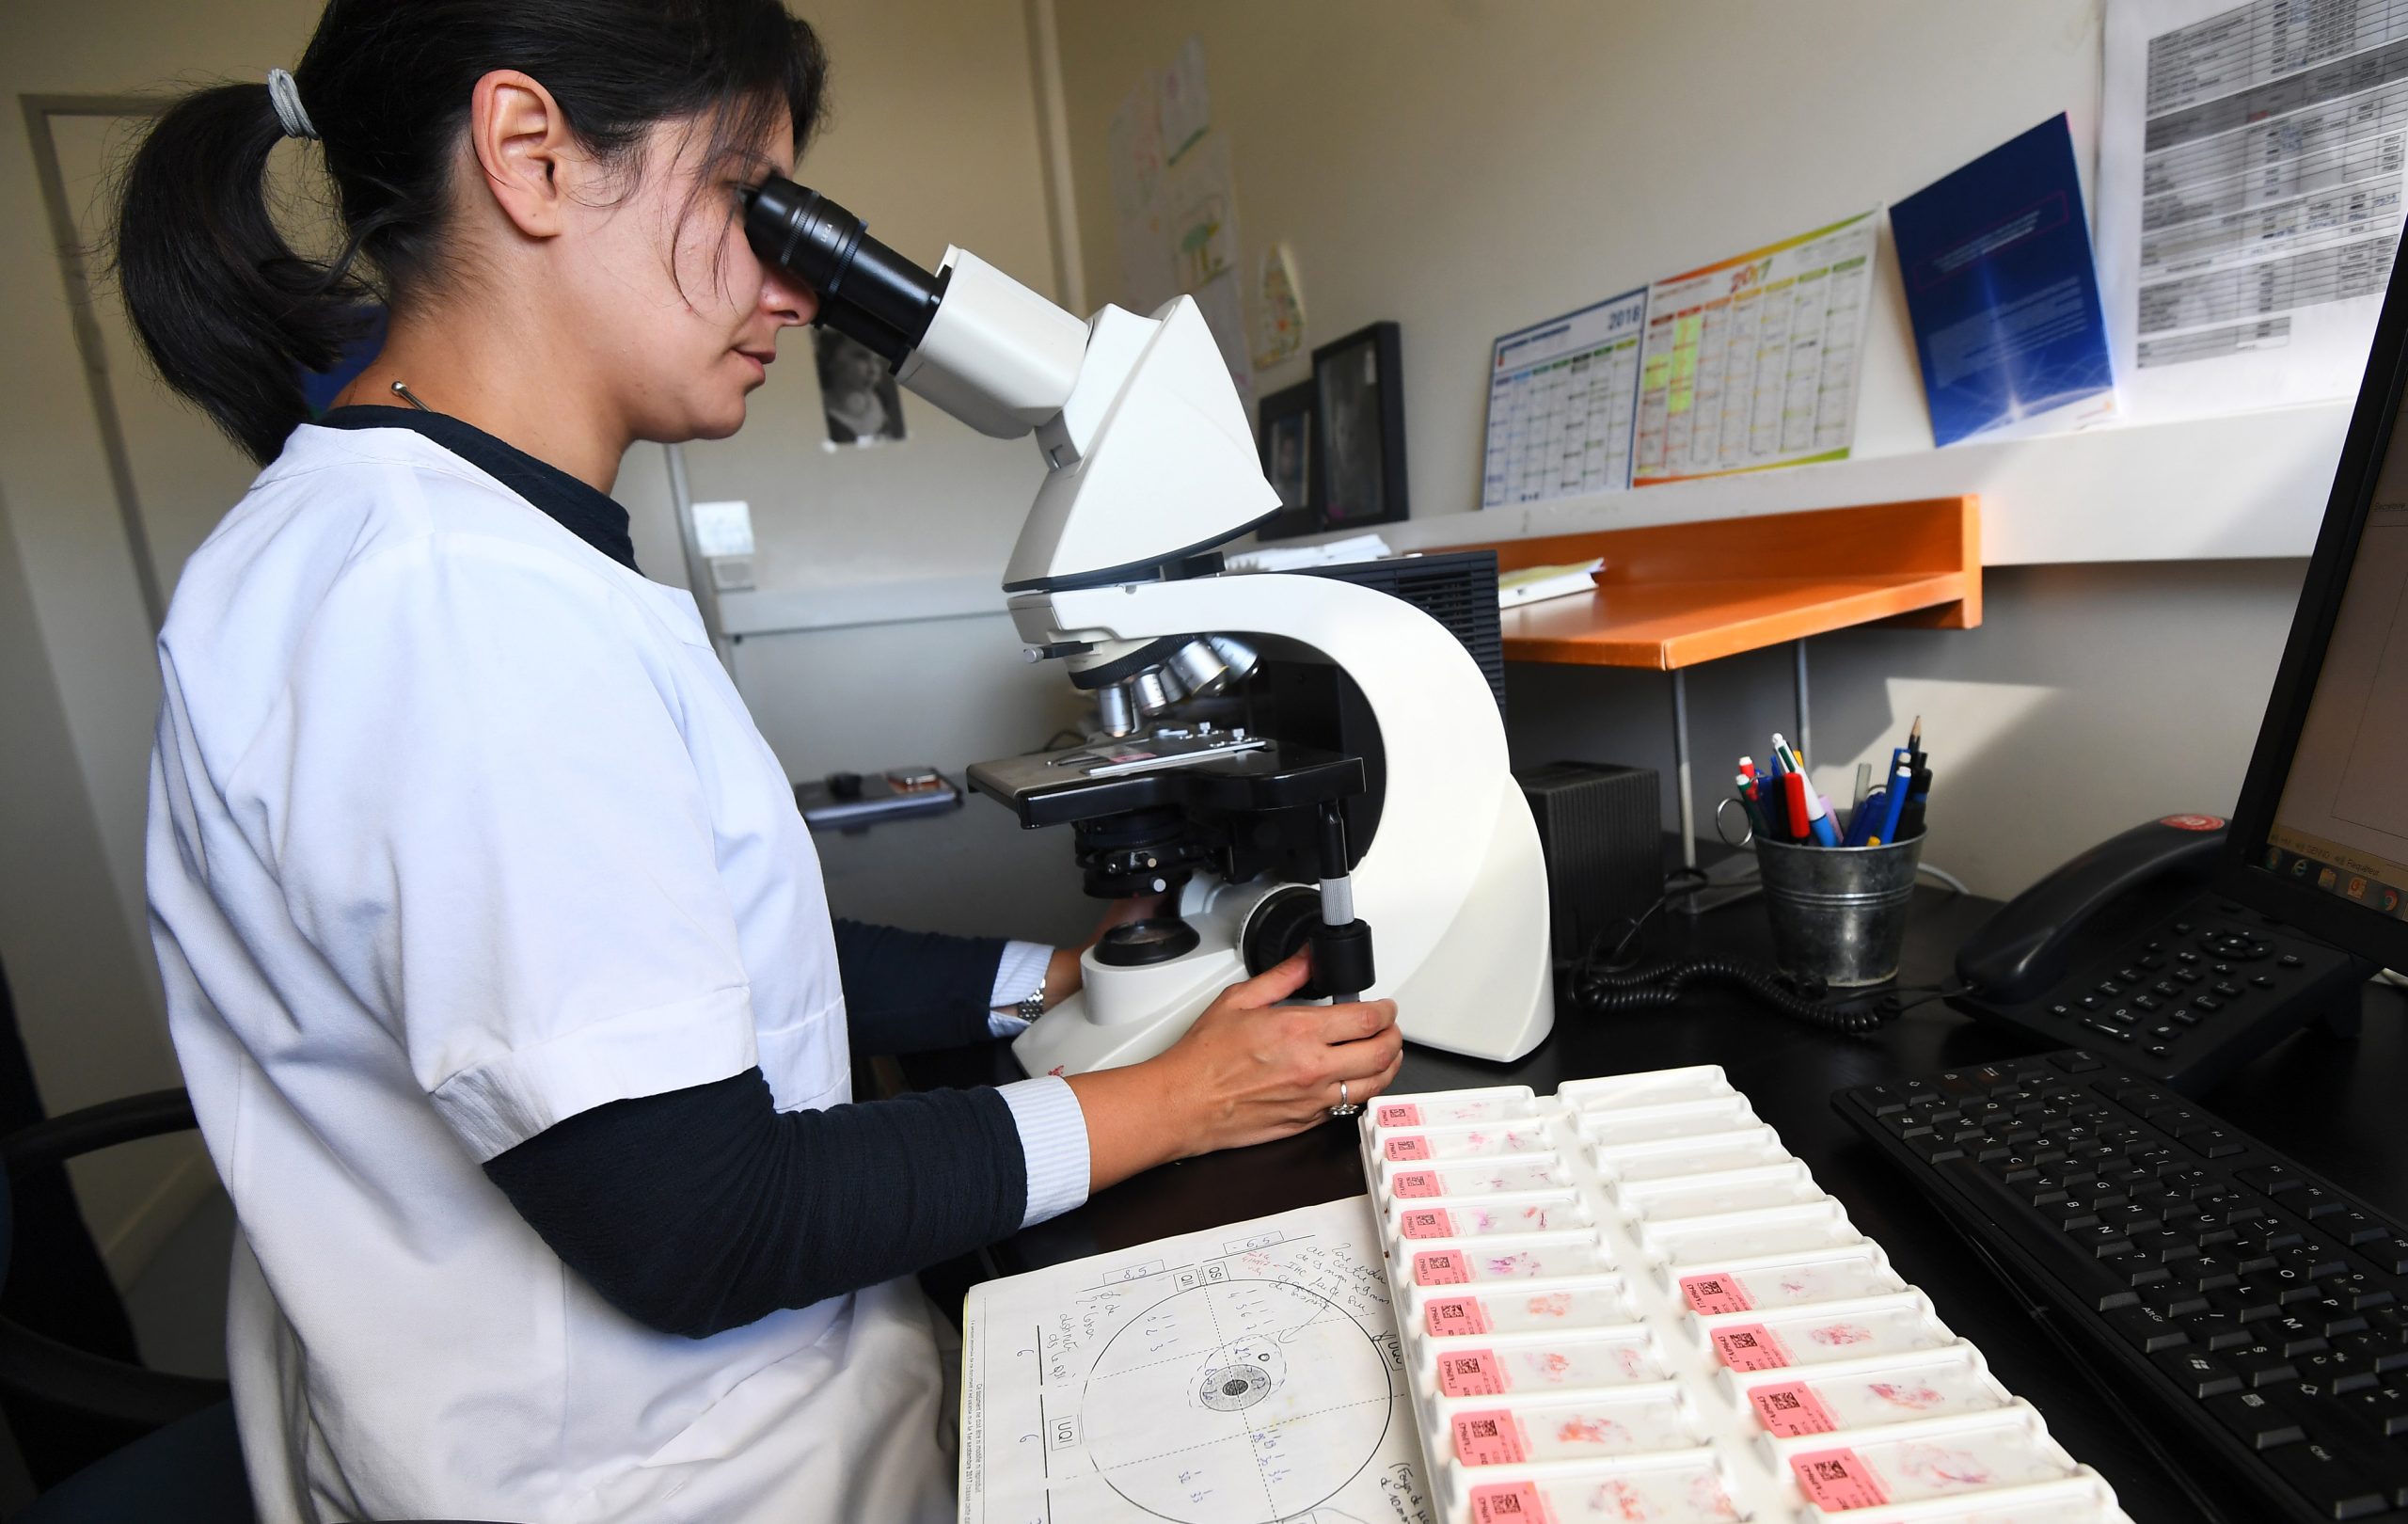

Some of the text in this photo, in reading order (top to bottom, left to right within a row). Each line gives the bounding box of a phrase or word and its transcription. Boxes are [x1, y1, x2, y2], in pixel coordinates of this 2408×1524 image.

[1730, 258, 1772, 294] 2017
[2199, 1257, 2216, 1265] K
[1123, 1266, 1148, 1280] 8,5
[1208, 1266, 1223, 1281] QSI
[1180, 1274, 1195, 1287] QII
[2282, 1318, 2304, 1329] M
[1057, 1422, 1073, 1444] UQI
